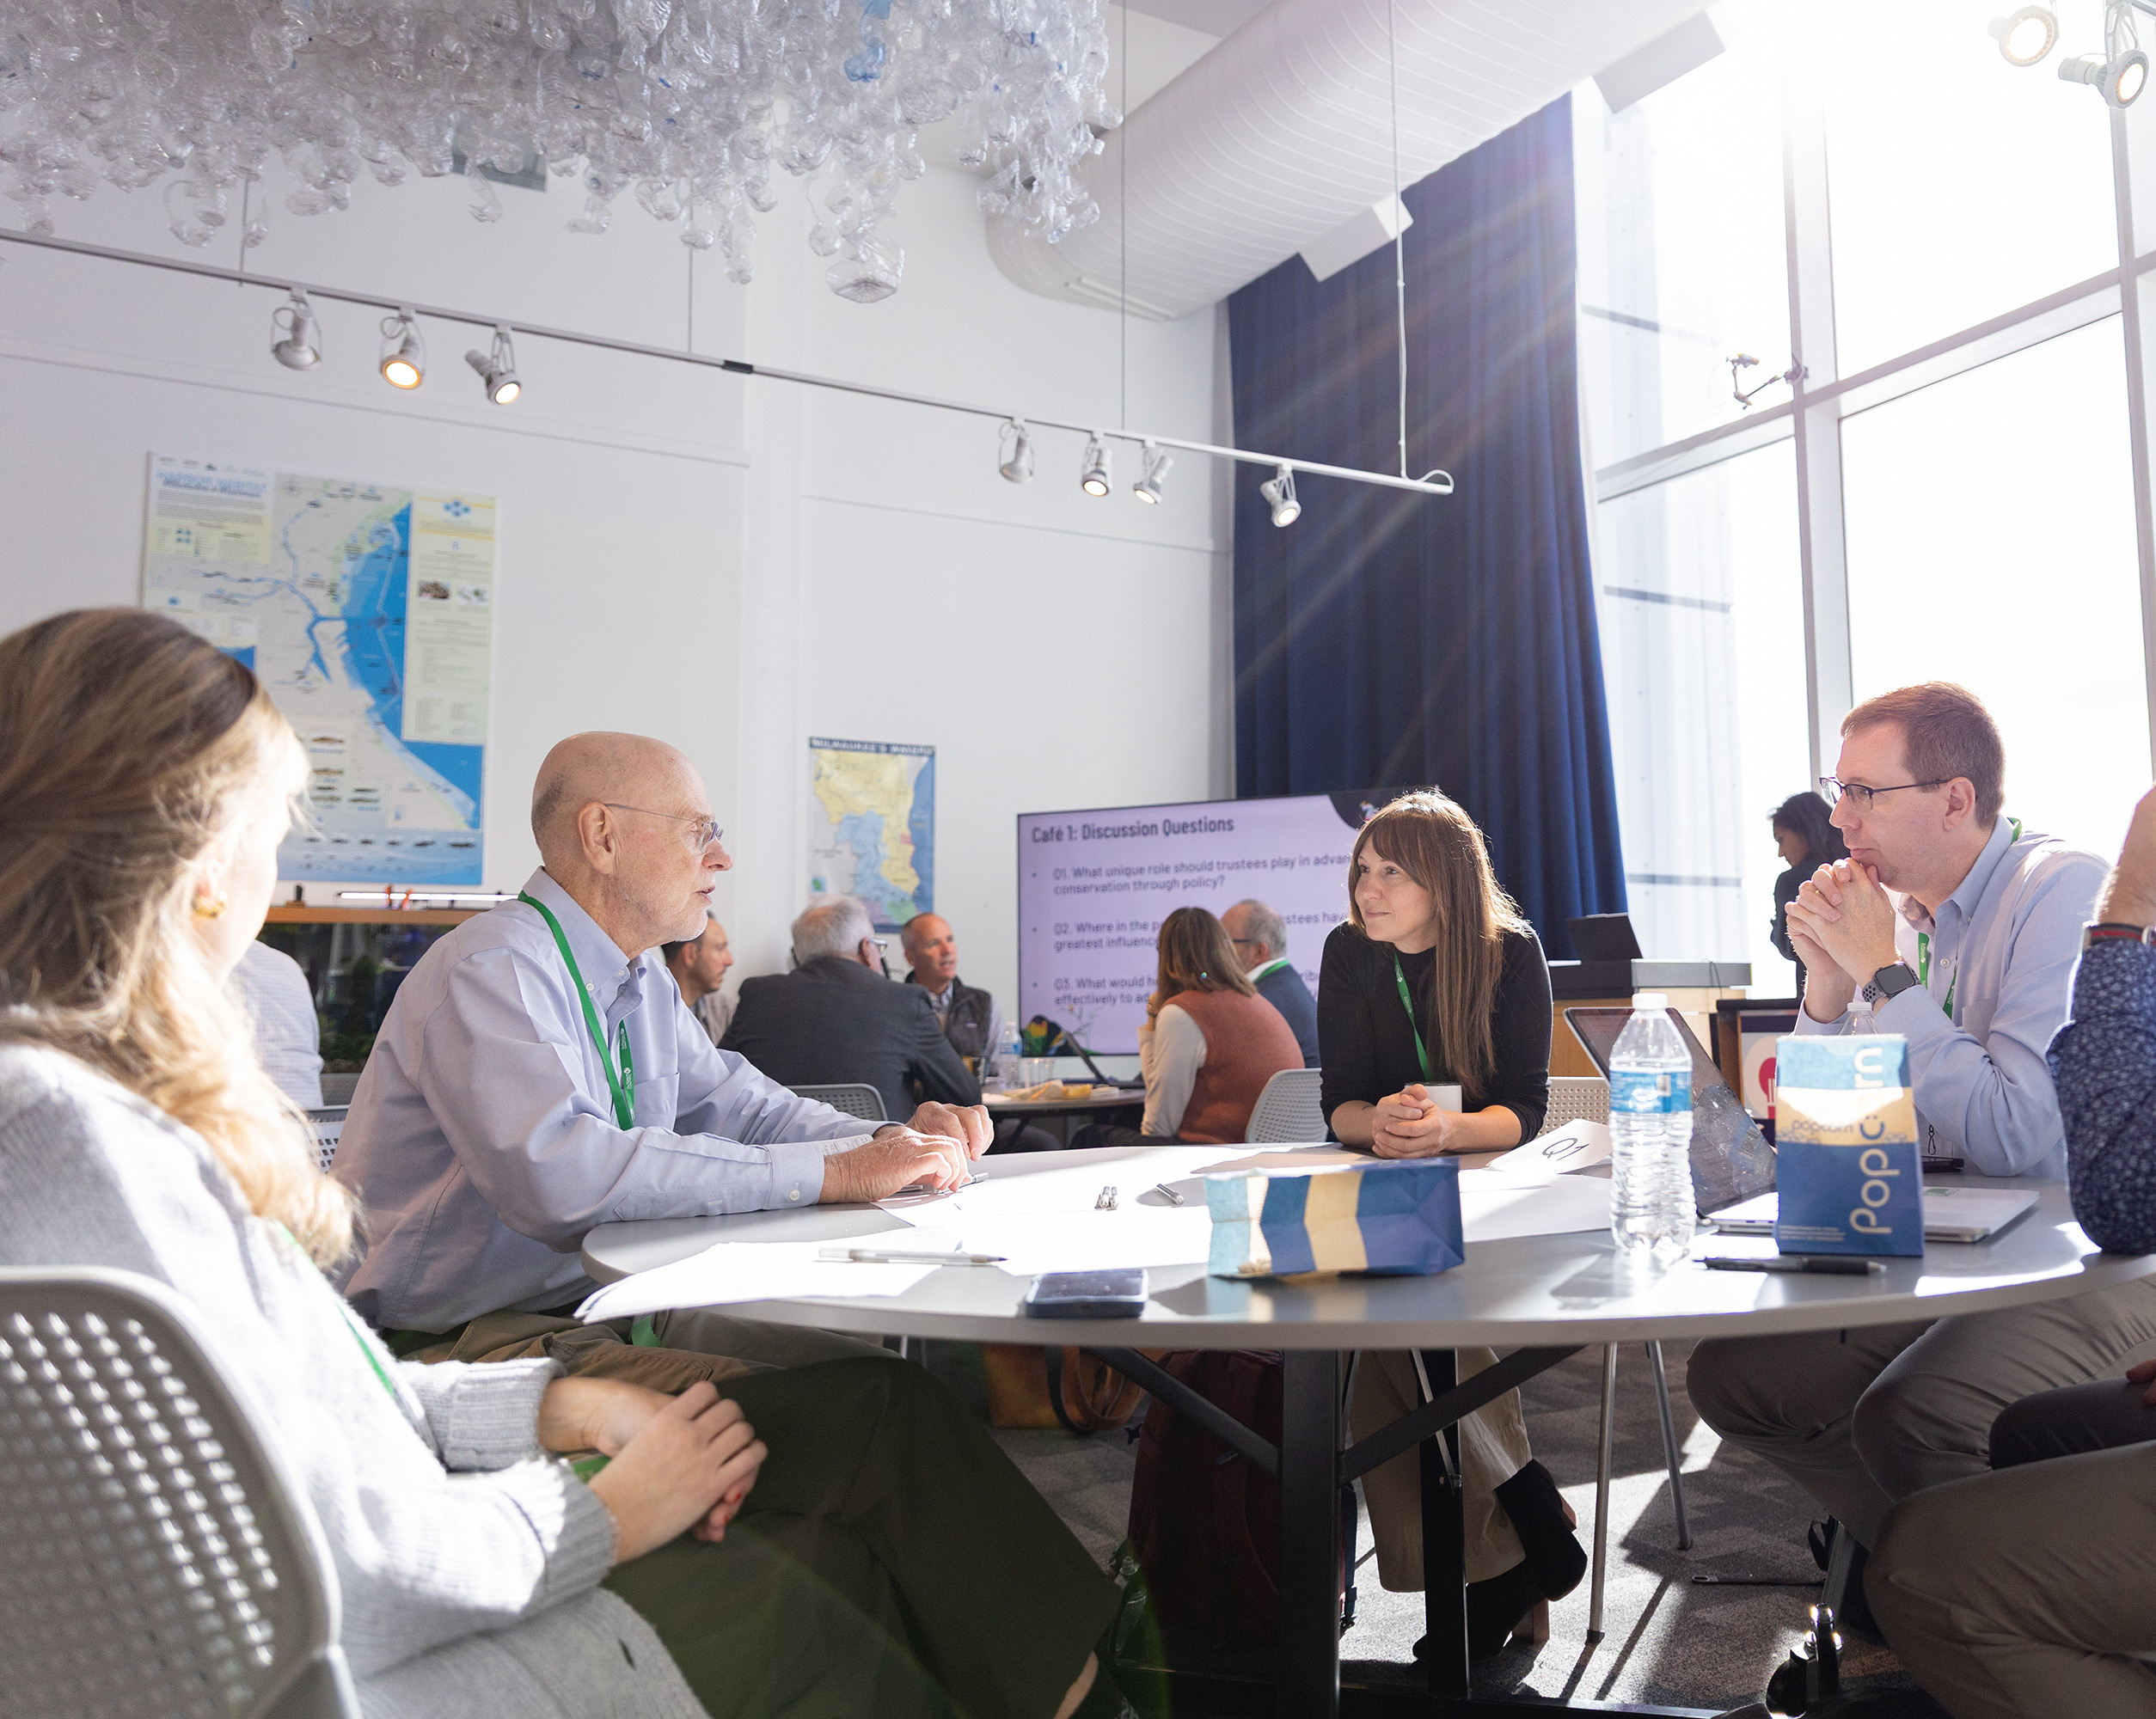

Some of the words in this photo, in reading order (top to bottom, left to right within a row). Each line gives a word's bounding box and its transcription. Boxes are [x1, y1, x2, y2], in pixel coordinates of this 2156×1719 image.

[1032, 826, 1063, 843] Café
[1067, 825, 1077, 841] 1:
[1081, 821, 1158, 840] Discussion
[1162, 817, 1234, 836] Questions
[1053, 867, 1070, 880] Q1.
[1072, 866, 1102, 878] What
[1105, 864, 1145, 878] unique
[1148, 863, 1171, 875] role
[1173, 860, 1214, 872] should
[1216, 859, 1267, 872] trustees
[1271, 856, 1295, 870] play
[1298, 855, 1311, 866] in
[1314, 854, 1351, 866] advan
[1053, 880, 1130, 895] conservation
[1132, 878, 1180, 892] through
[1182, 875, 1226, 890] policy?
[1075, 921, 1113, 933] Where
[1116, 921, 1127, 931] in
[1129, 920, 1149, 931] the
[1283, 914, 1320, 923] stees
[1054, 938, 1104, 951] greatest
[1076, 977, 1106, 988] What
[1109, 976, 1145, 988] would
[1055, 994, 1118, 1006] effectively
[1119, 993, 1133, 1003] to
[1542, 1137, 1590, 1161] Q1
